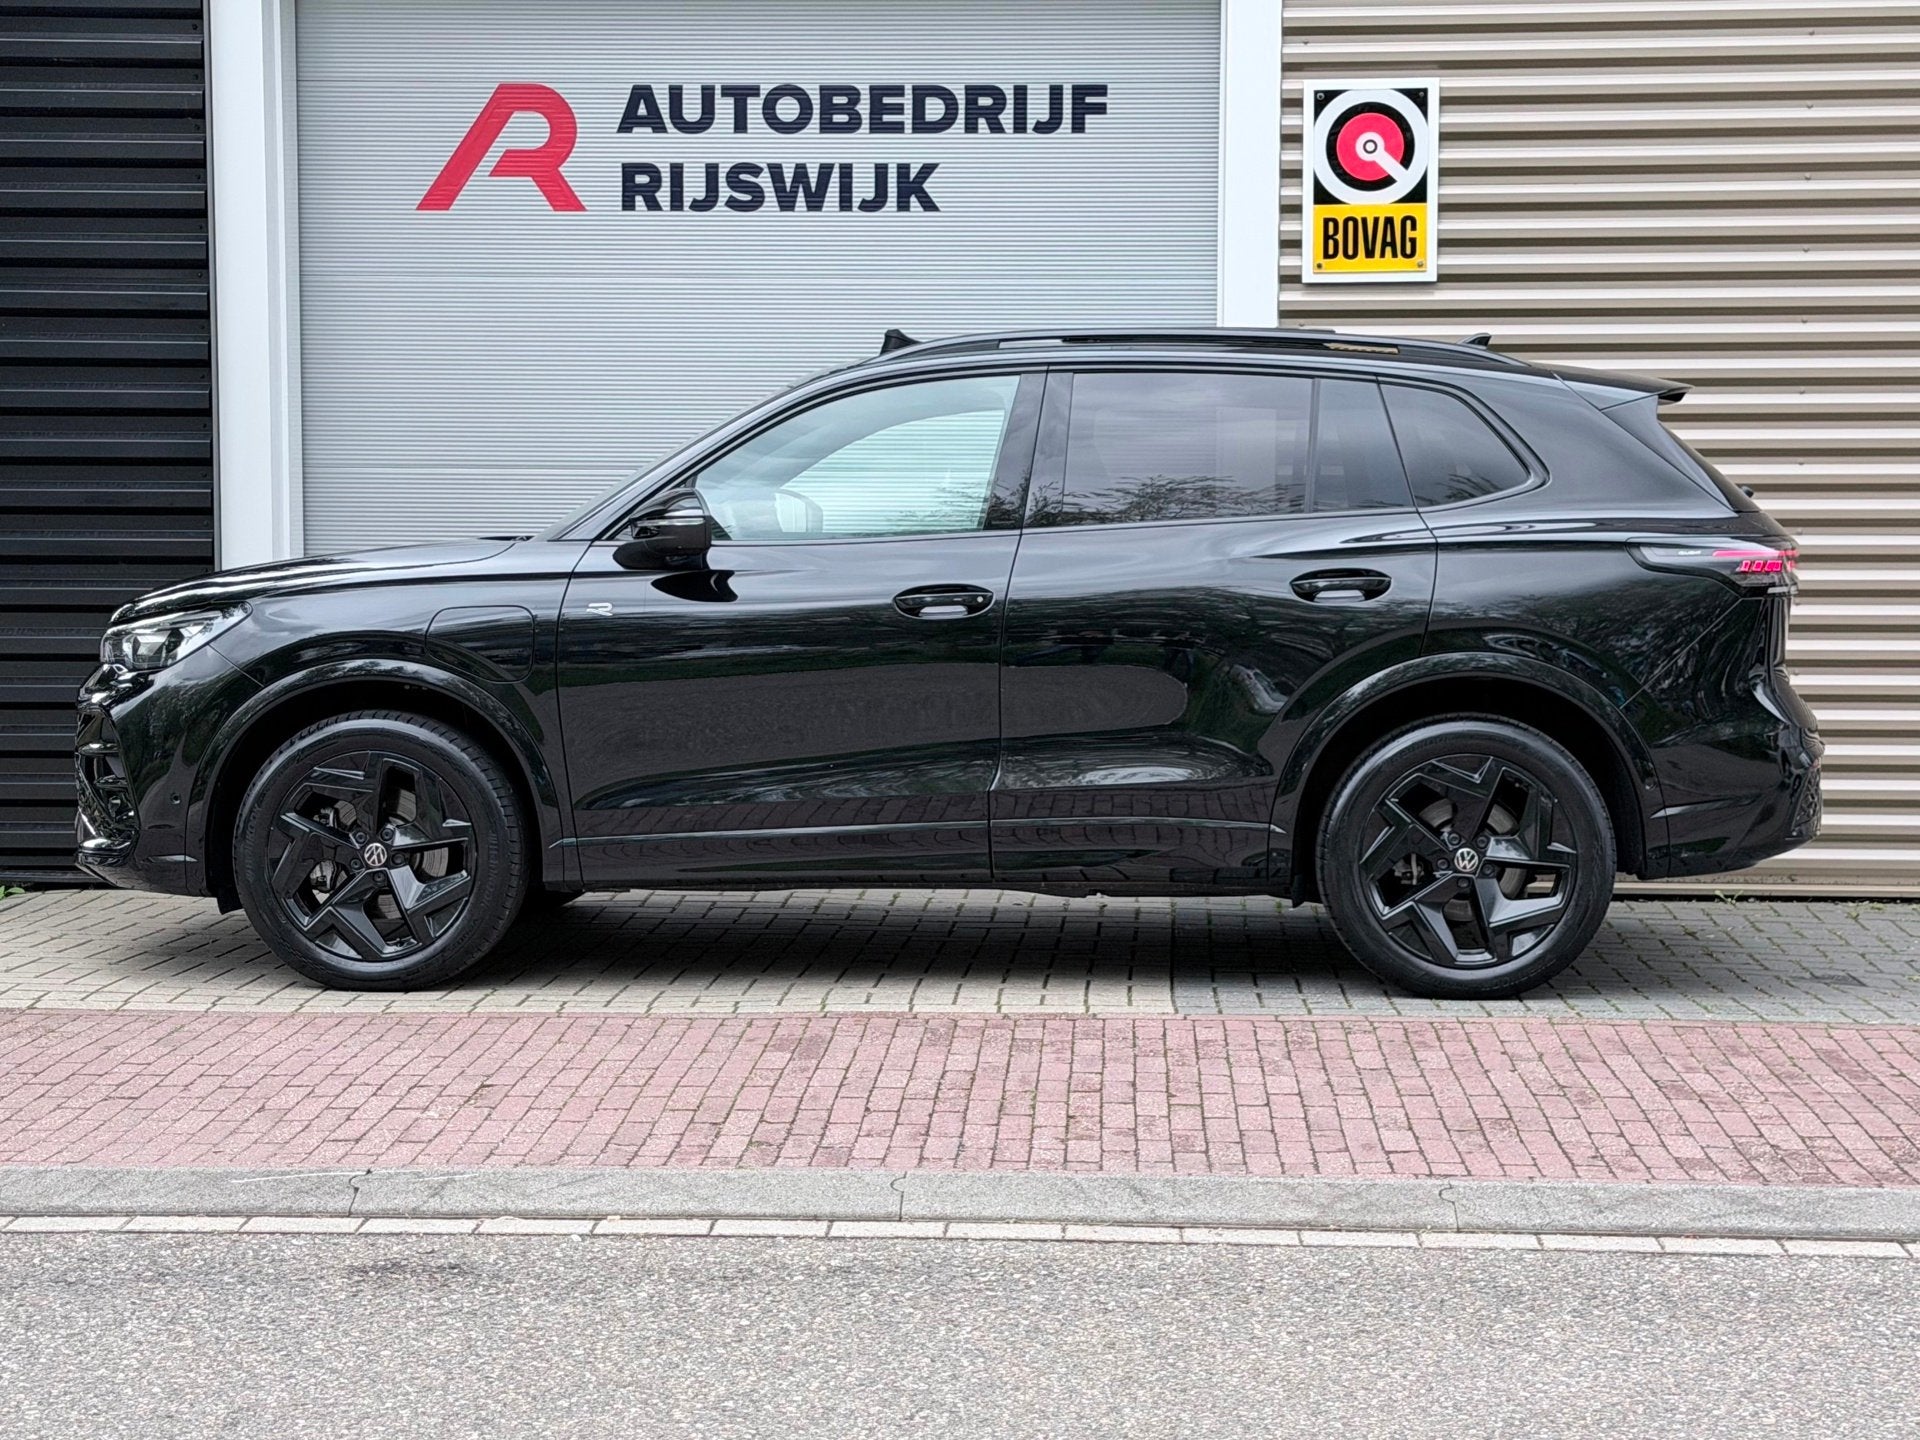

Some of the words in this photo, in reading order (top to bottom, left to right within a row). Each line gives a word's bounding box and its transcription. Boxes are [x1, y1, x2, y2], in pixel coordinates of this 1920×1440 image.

[617, 85, 1107, 134] AUTOBEDRIJF
[622, 162, 940, 212] RIJSWIJK
[1323, 215, 1417, 260] BOVAG
